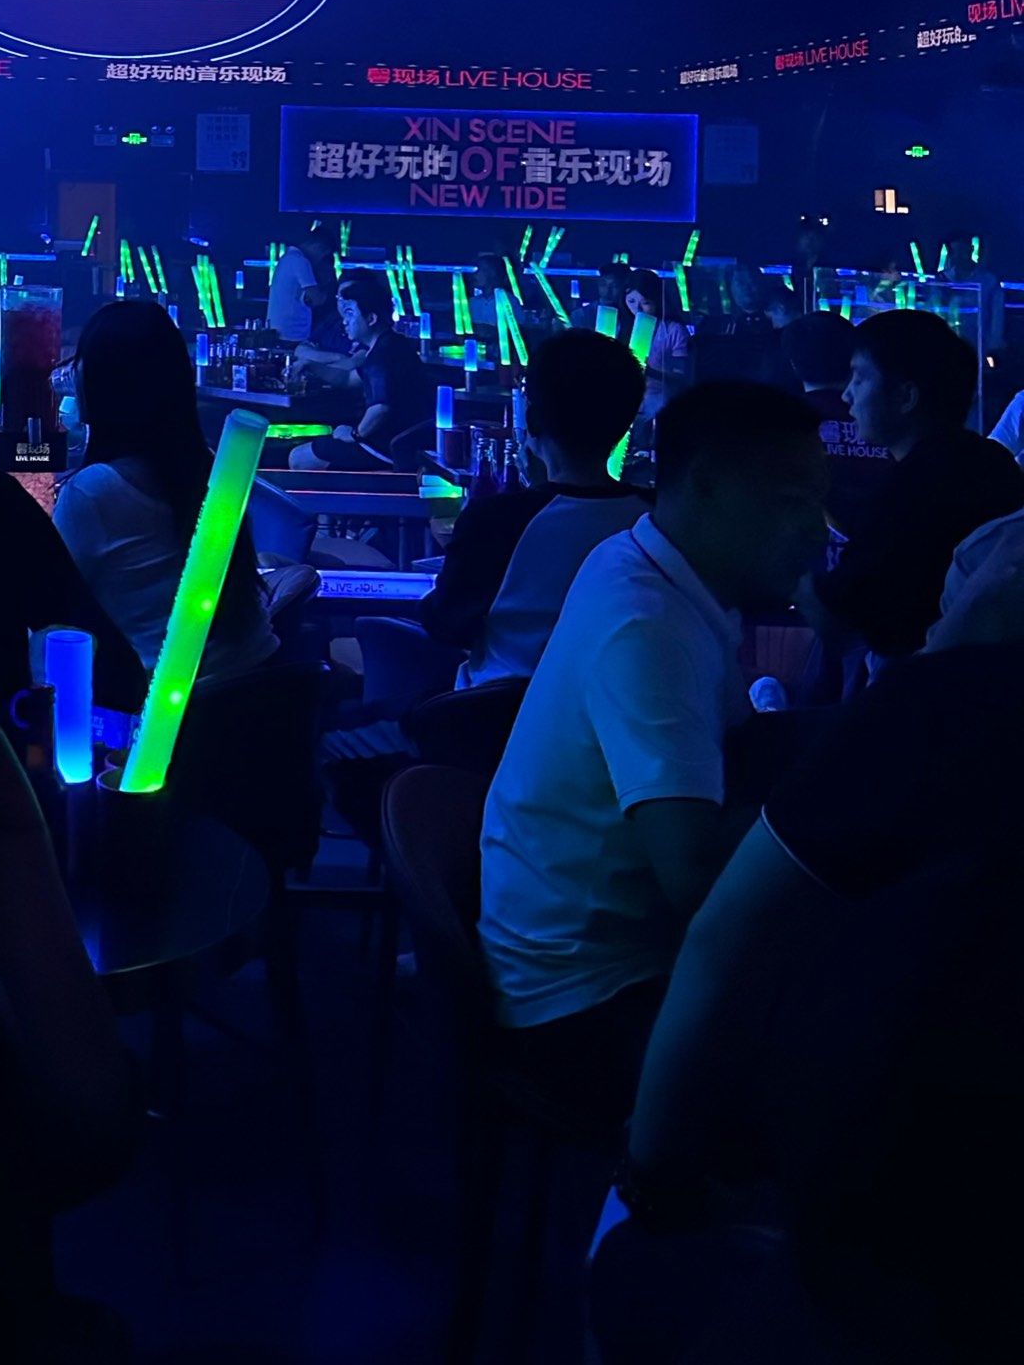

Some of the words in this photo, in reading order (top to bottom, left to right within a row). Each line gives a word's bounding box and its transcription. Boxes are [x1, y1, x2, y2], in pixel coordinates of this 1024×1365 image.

[805, 46, 827, 66] LIVE
[828, 39, 870, 61] HOUSE
[105, 63, 287, 83] 超好玩的音乐现场
[445, 69, 498, 87] LIVE
[503, 71, 593, 90] HOUSE
[403, 116, 460, 142] XIN
[468, 119, 577, 145] SCENE
[307, 141, 458, 180] 超好玩的
[460, 146, 519, 182] OF
[520, 147, 672, 188] 音乐现场
[410, 183, 488, 209] NEW
[500, 185, 567, 211] TIDE
[15, 455, 29, 463] LIVE
[30, 455, 50, 463] HOUSE
[825, 443, 846, 457] IVE
[847, 444, 889, 460] HOUSE
